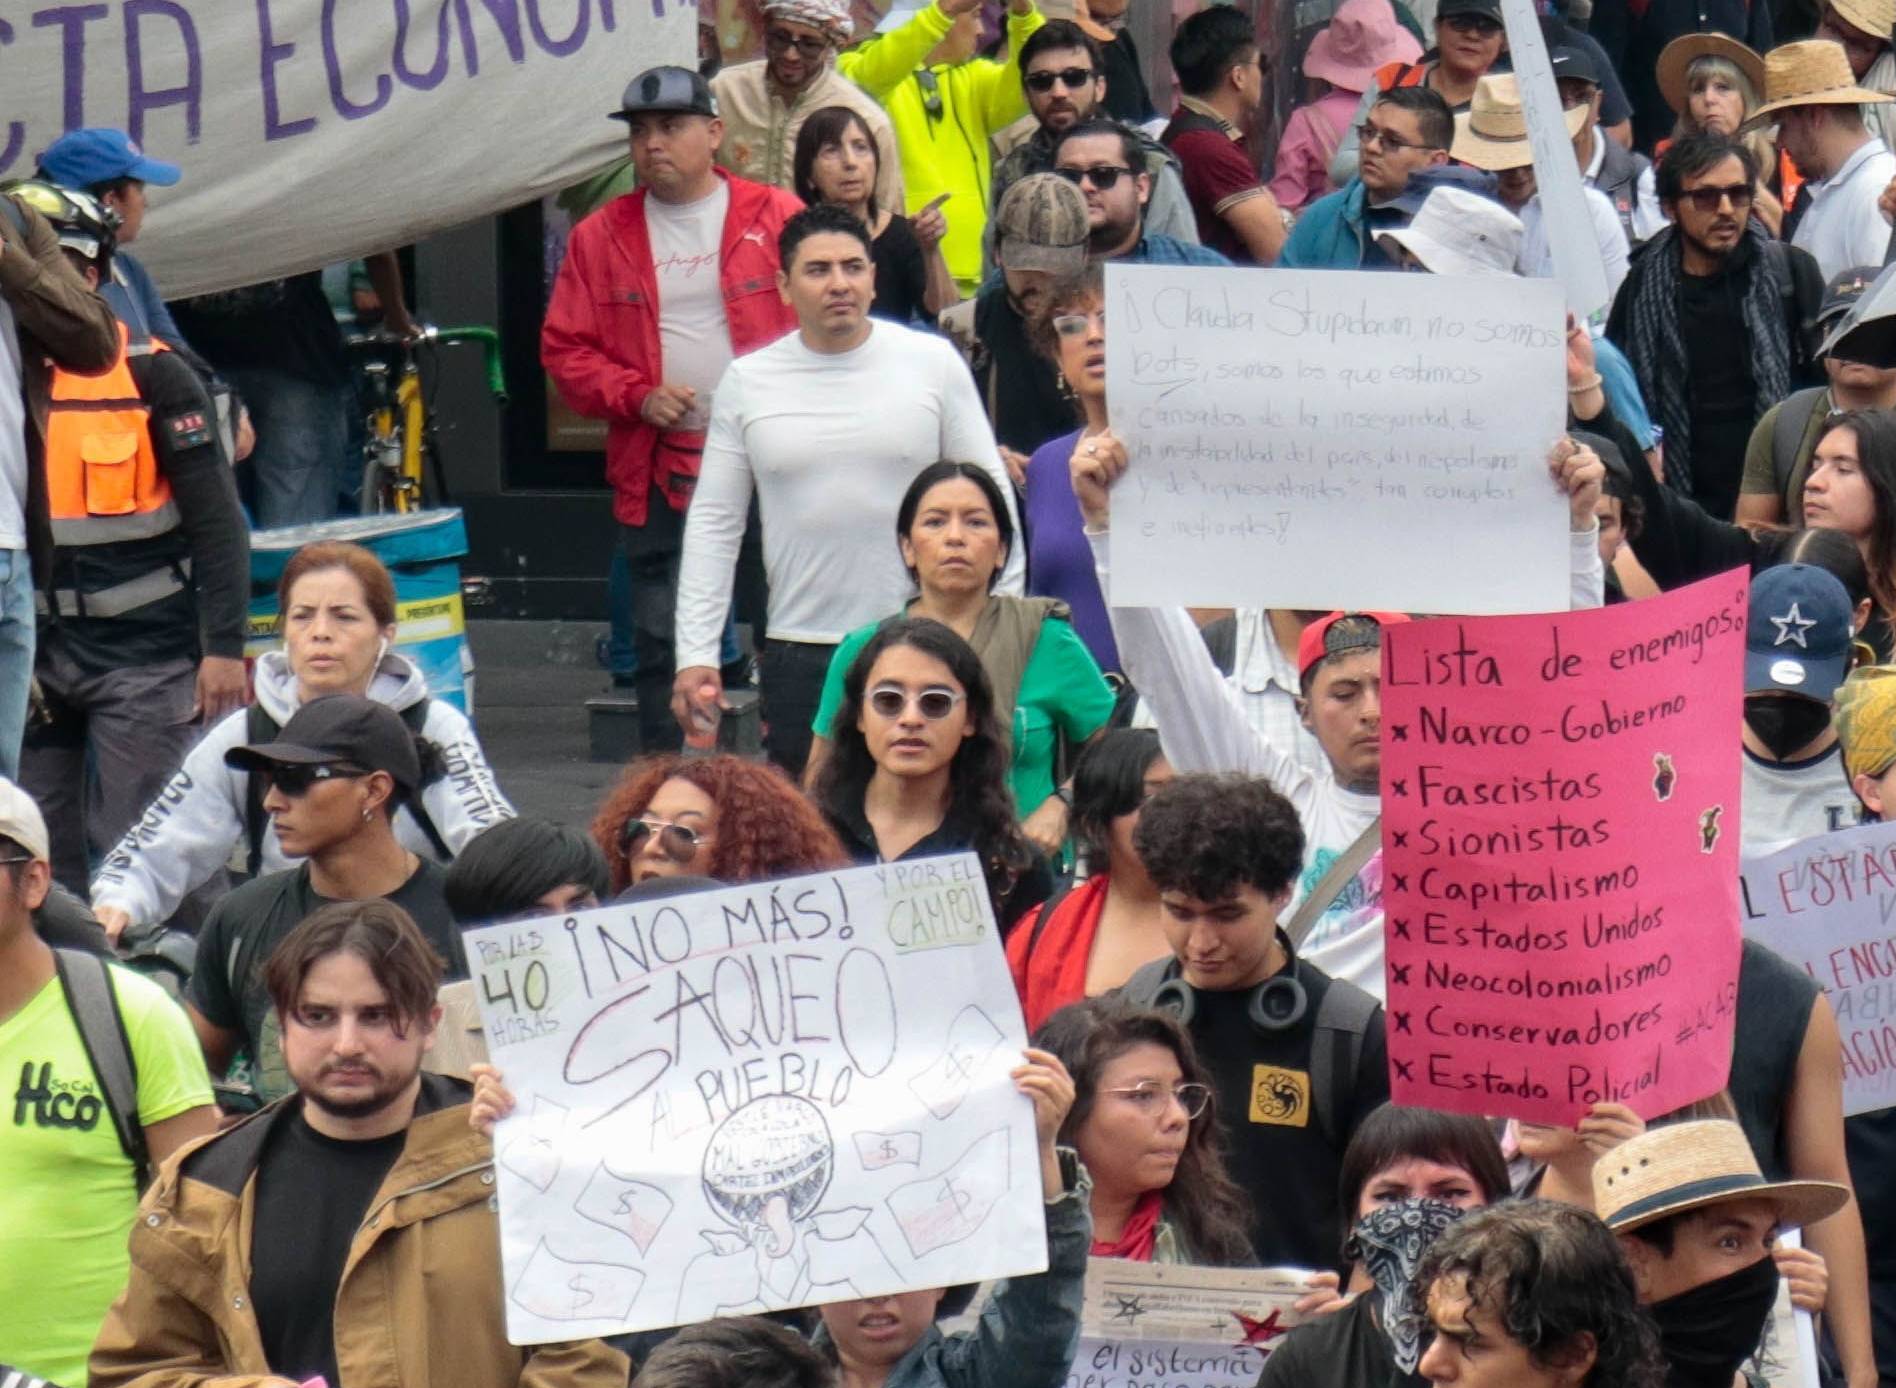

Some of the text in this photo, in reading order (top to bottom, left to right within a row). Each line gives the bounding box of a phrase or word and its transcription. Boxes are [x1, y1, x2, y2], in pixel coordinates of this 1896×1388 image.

[1473, 318, 1562, 349] somos
[1386, 626, 1503, 688] Lista
[1541, 627, 1582, 682] de
[1418, 765, 1603, 808] Fascistas
[1418, 817, 1611, 857] Sionistas
[1419, 863, 1640, 910] Capitalismo
[564, 877, 855, 999] ¡NO MÁS!
[1423, 904, 1665, 953] Estados Unidos
[481, 958, 550, 1016] 40
[1425, 952, 1673, 1000] Neocolonialismo
[562, 945, 898, 1131] SAQUEO
[1426, 1001, 1665, 1048] Conservadores
[695, 1052, 854, 1125] PUEBLO
[1428, 1044, 1662, 1106] Estado Policial
[1093, 1344, 1119, 1371] el
